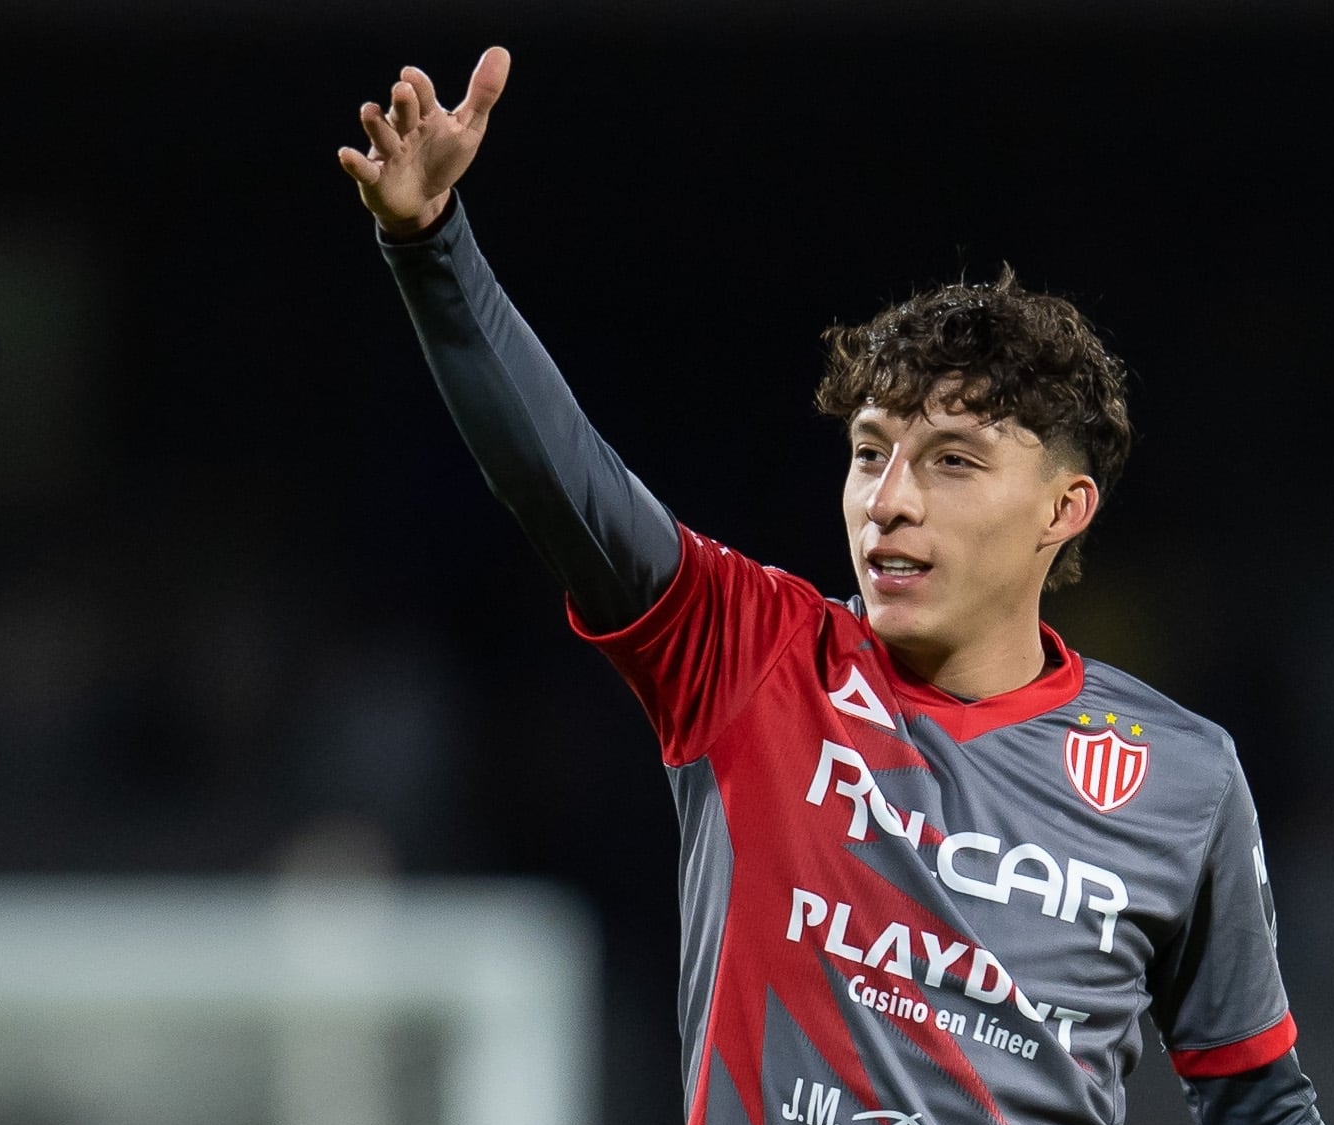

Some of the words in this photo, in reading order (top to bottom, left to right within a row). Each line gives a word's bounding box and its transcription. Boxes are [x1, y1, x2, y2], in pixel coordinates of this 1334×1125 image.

[848, 974, 928, 1023] Casino
[935, 1009, 967, 1035] en
[972, 1012, 1040, 1060] Línea
